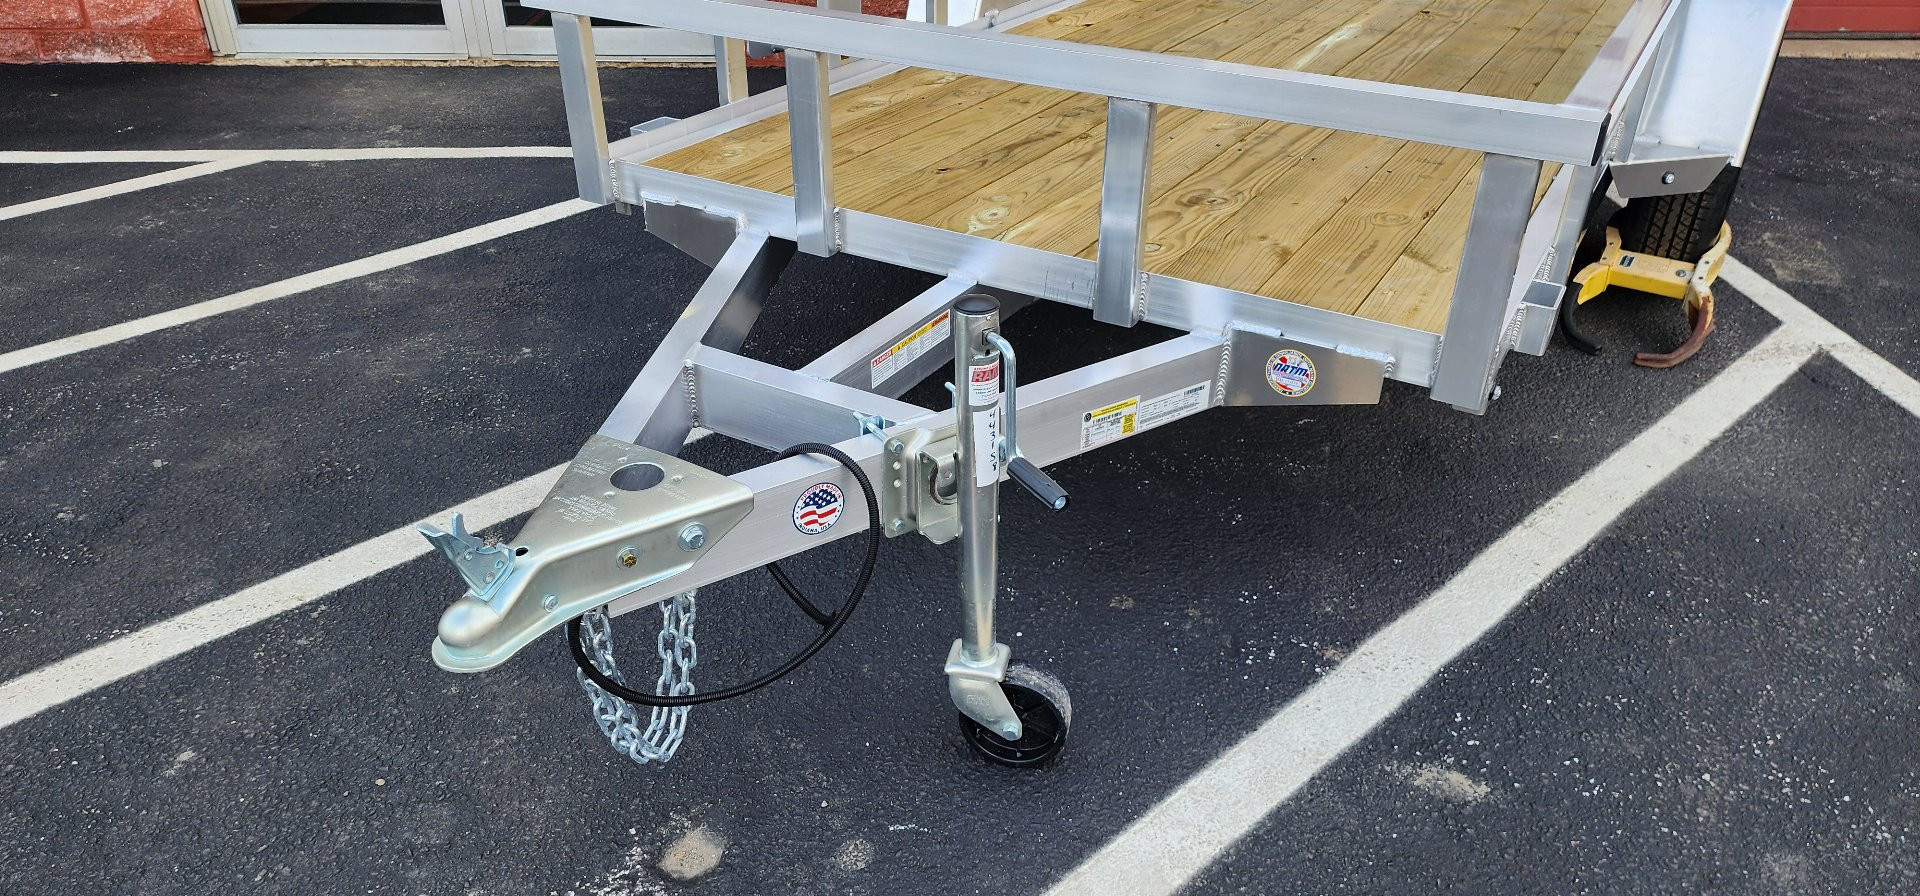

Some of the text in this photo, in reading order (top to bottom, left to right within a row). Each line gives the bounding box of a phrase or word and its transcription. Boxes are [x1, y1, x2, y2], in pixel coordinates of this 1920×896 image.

[1273, 363, 1308, 377] NATM
[800, 484, 824, 501] PROUDLY
[826, 484, 839, 493] MADE
[820, 522, 832, 531] USA
